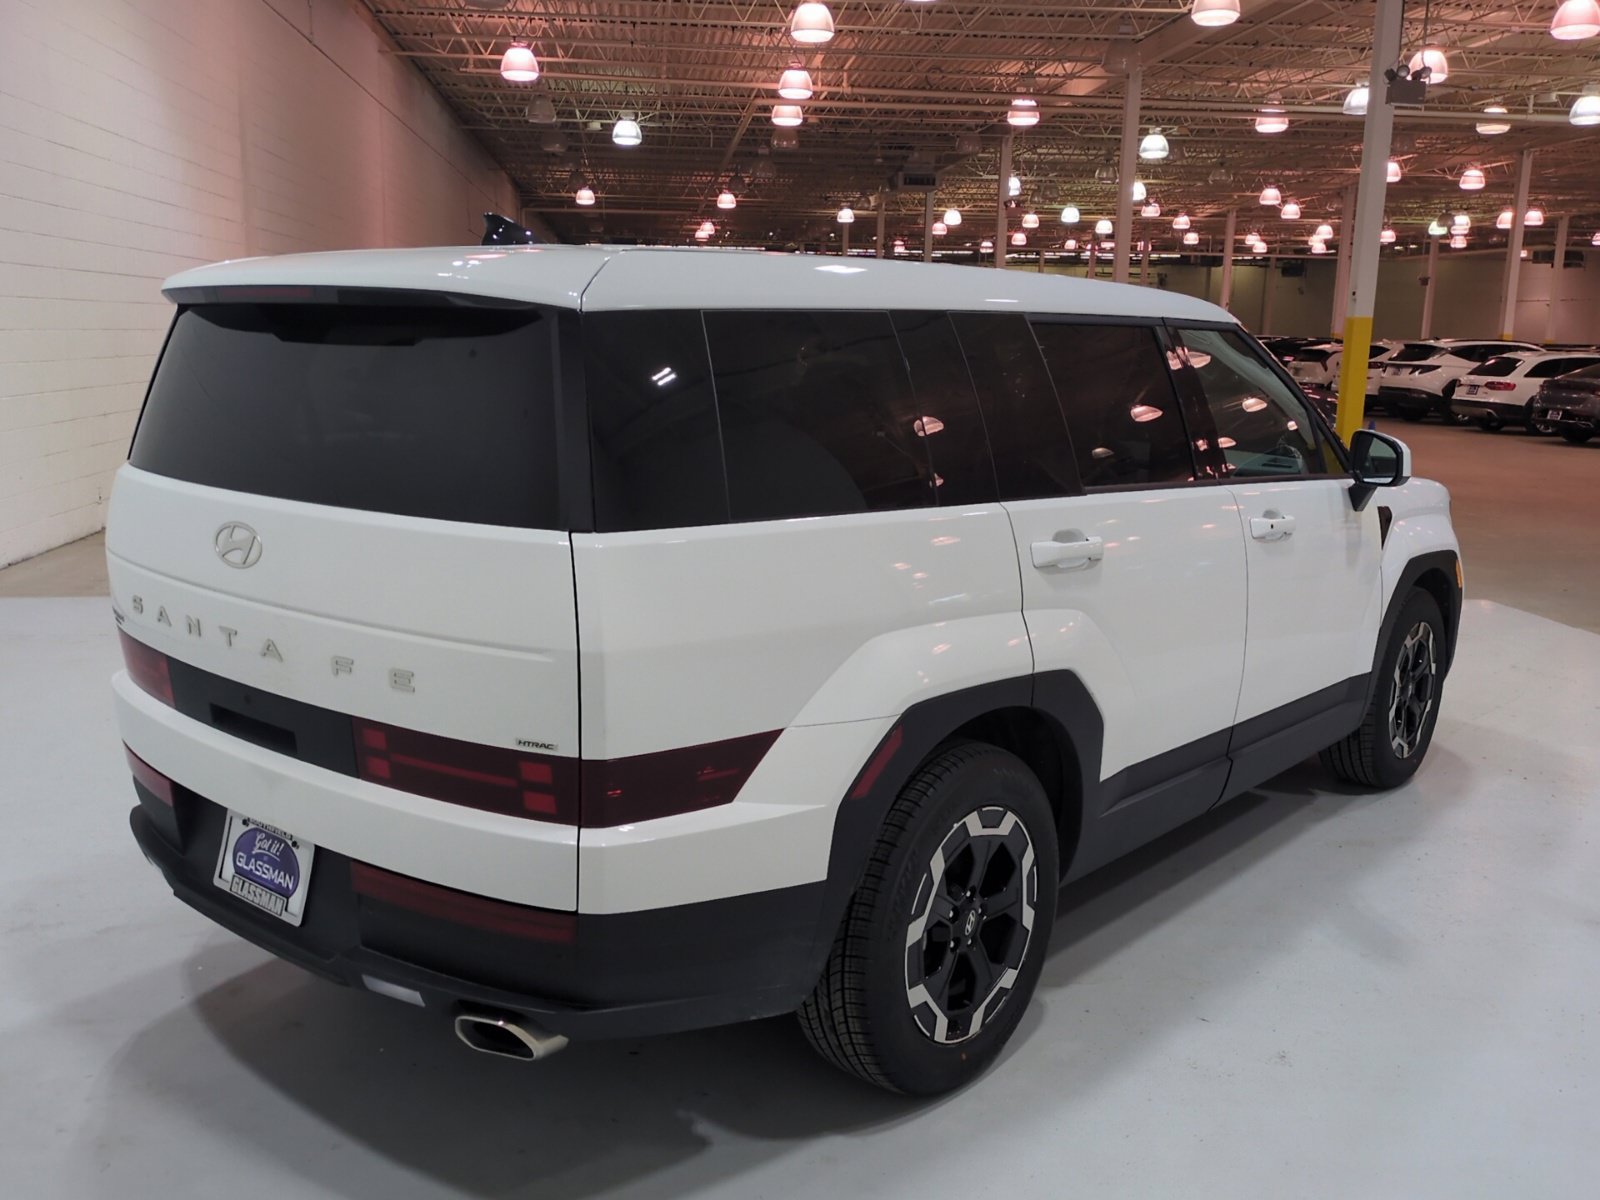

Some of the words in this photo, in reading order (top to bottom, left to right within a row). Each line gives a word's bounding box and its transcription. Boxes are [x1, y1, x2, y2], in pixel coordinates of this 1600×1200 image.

[132, 594, 284, 662] SANTA
[330, 654, 416, 694] FE
[517, 739, 556, 751] HTRAC
[252, 831, 272, 855] Got
[235, 851, 295, 891] GLASSMAN
[231, 876, 285, 917] GLASSMAN
